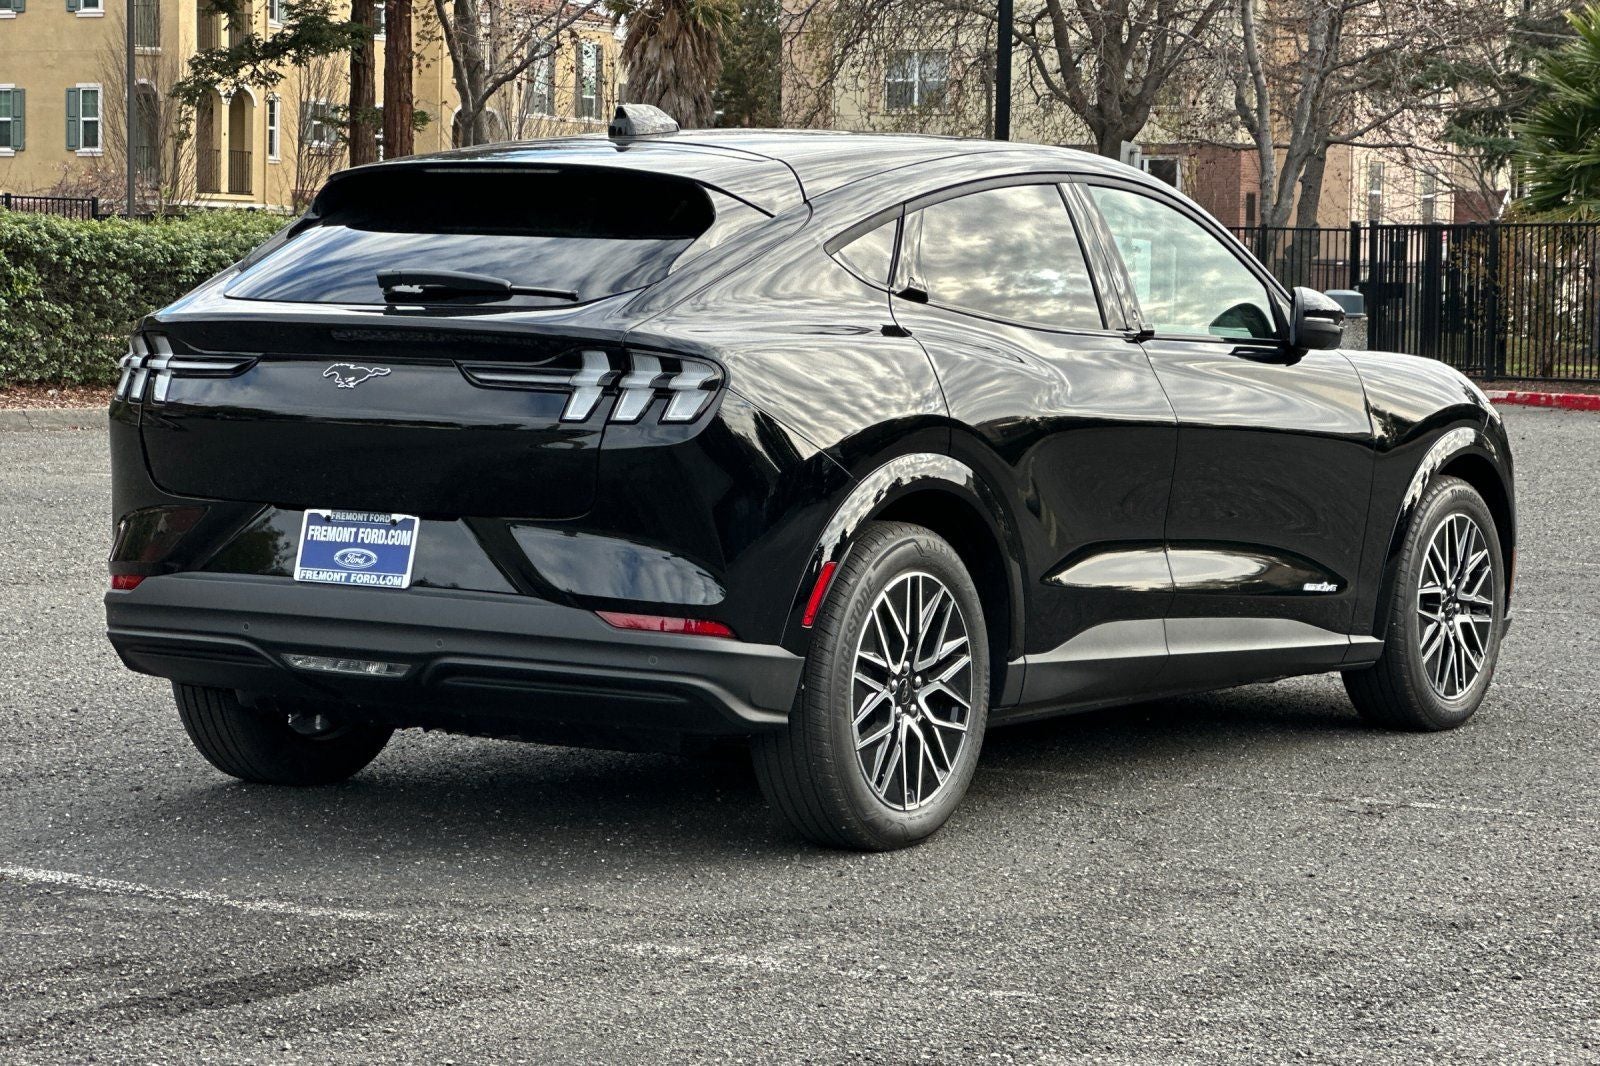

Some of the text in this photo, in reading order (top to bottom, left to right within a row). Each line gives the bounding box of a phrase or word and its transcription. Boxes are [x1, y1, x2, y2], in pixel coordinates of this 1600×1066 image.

[331, 511, 391, 523] FREMONT FORD
[307, 525, 412, 546] FREMONT FORD.COM
[344, 552, 366, 565] Ford
[300, 569, 403, 586] FREMONT FORD.COM
